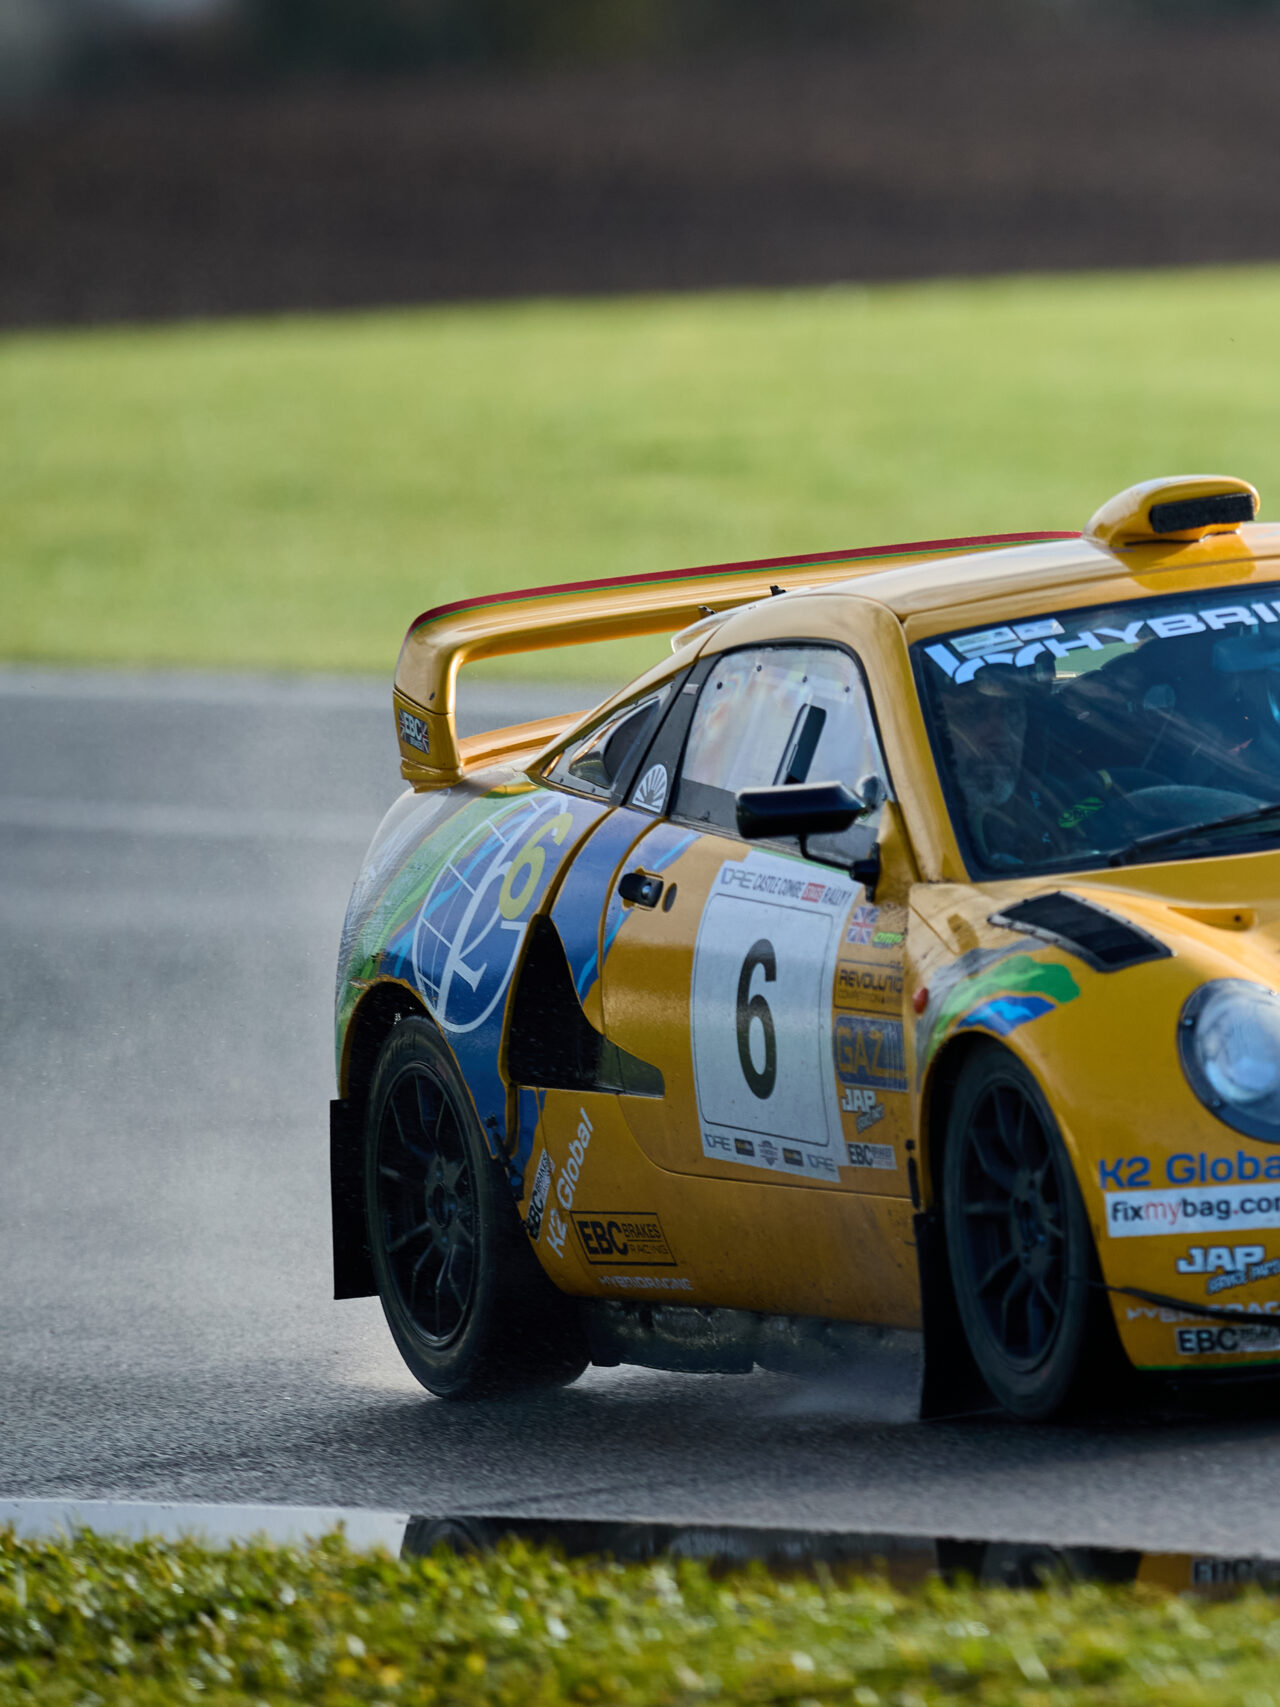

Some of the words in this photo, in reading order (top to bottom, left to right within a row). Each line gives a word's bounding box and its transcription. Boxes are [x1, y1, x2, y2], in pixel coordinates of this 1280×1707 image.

[839, 968, 904, 993] REVOLUTIO
[735, 938, 777, 1099] 6
[841, 1089, 876, 1113] JAP
[556, 1106, 594, 1211] Global
[848, 1144, 874, 1167] EBC
[1098, 1154, 1152, 1190] K2
[546, 1207, 568, 1259] K2
[576, 1219, 630, 1256] EBC
[621, 1222, 663, 1240] BRAKES
[1176, 1244, 1266, 1275] JAP
[1177, 1328, 1240, 1353] EBC
